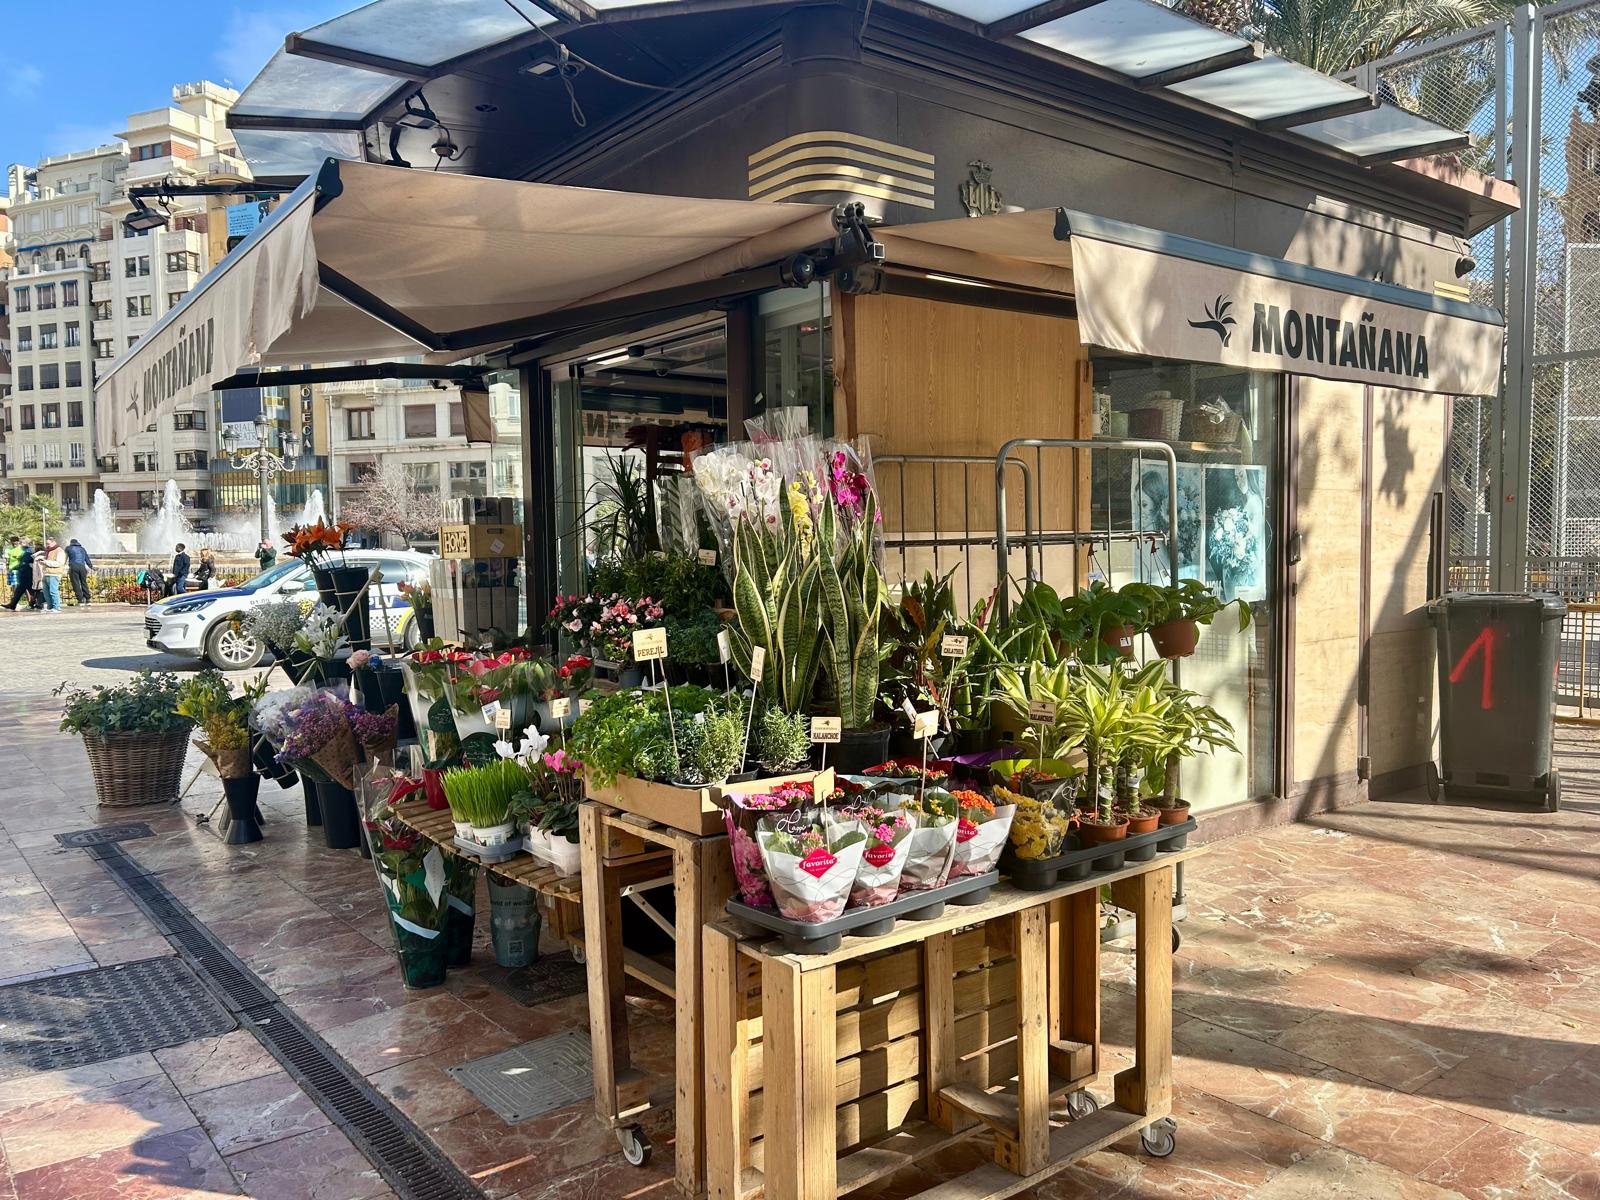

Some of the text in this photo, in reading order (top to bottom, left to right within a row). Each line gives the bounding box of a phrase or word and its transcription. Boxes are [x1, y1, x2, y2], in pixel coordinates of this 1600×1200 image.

[1252, 303, 1430, 379] MONTAÑANA
[301, 386, 312, 449] OTECA
[443, 531, 467, 553] HOME
[1449, 627, 1494, 711] 1
[802, 857, 836, 869] favorita
